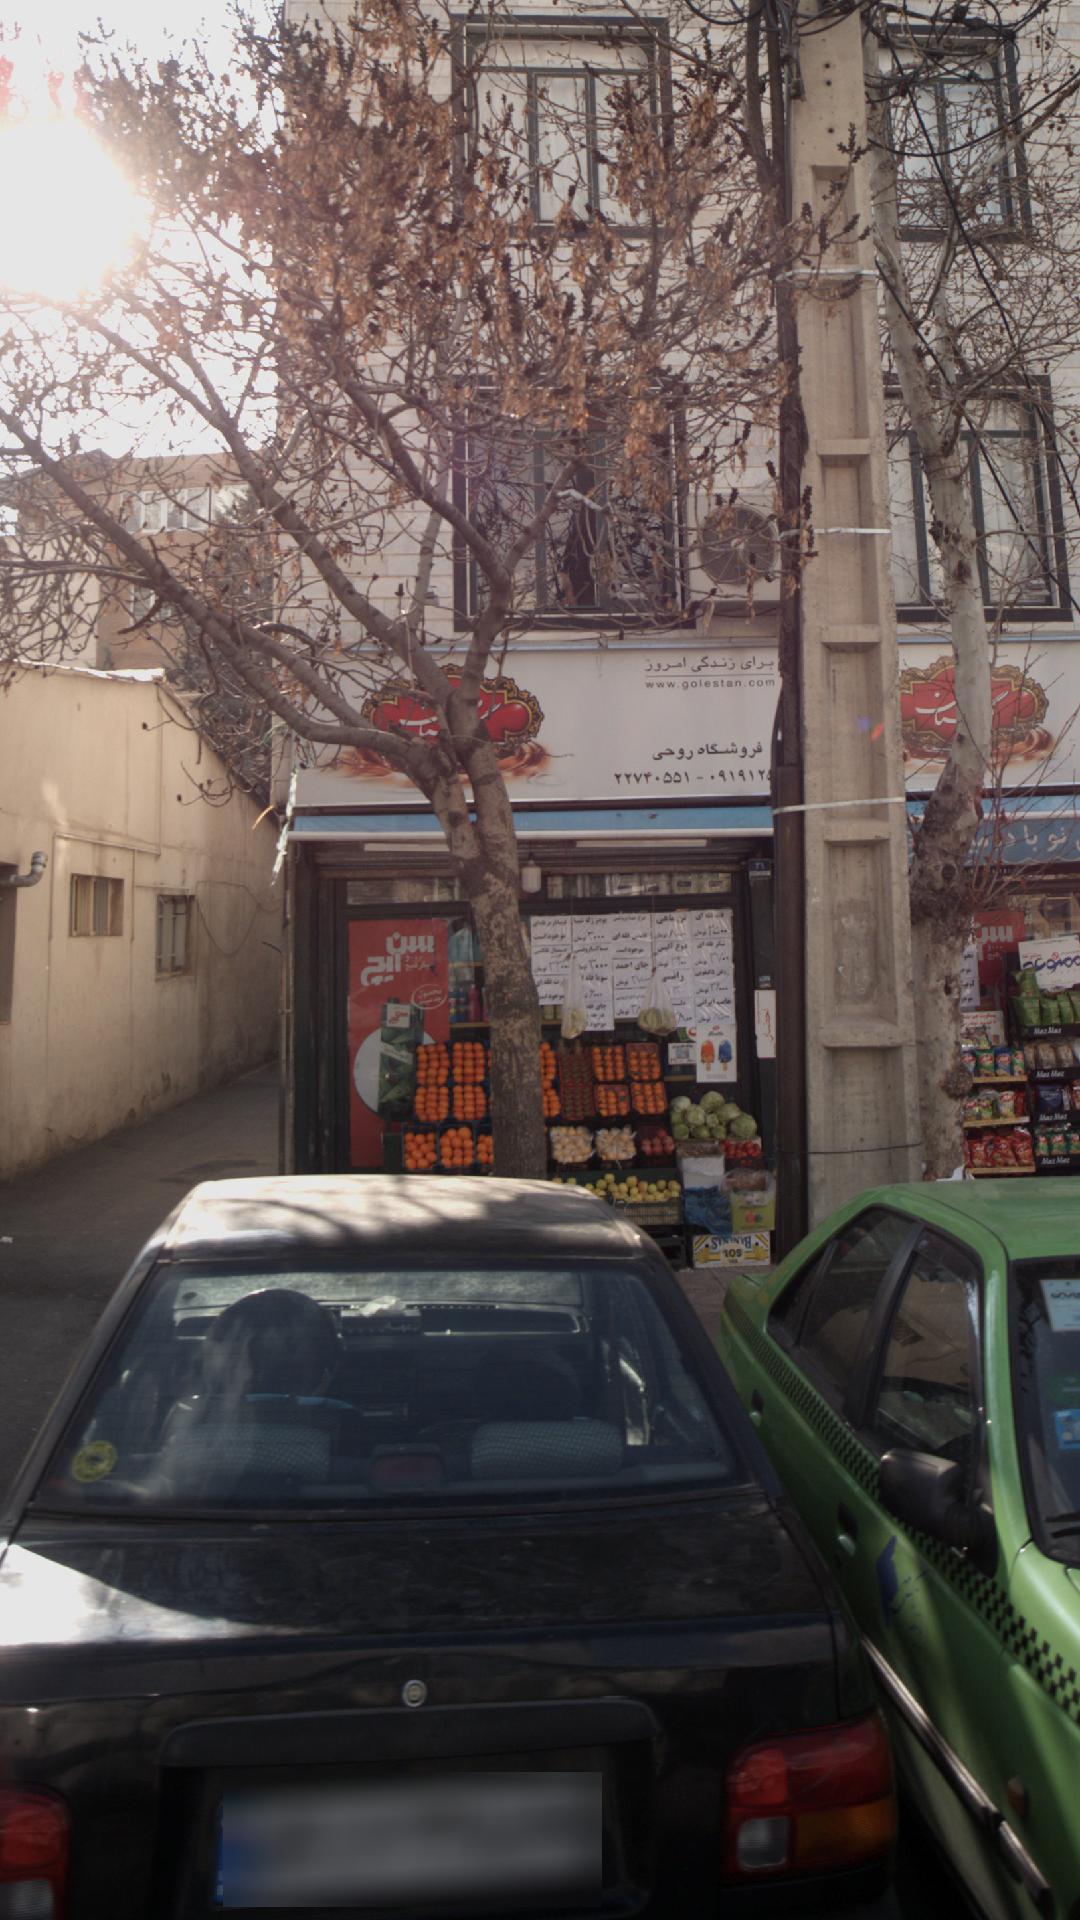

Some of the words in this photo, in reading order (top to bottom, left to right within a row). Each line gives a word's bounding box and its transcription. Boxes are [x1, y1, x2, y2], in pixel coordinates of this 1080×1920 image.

[645, 657, 686, 672] امروز
[691, 656, 736, 672] زندگی
[741, 656, 774, 670] برای
[645, 678, 775, 691] www.golestan.com
[652, 747, 693, 761] روحی
[697, 742, 763, 758] فروشگاه
